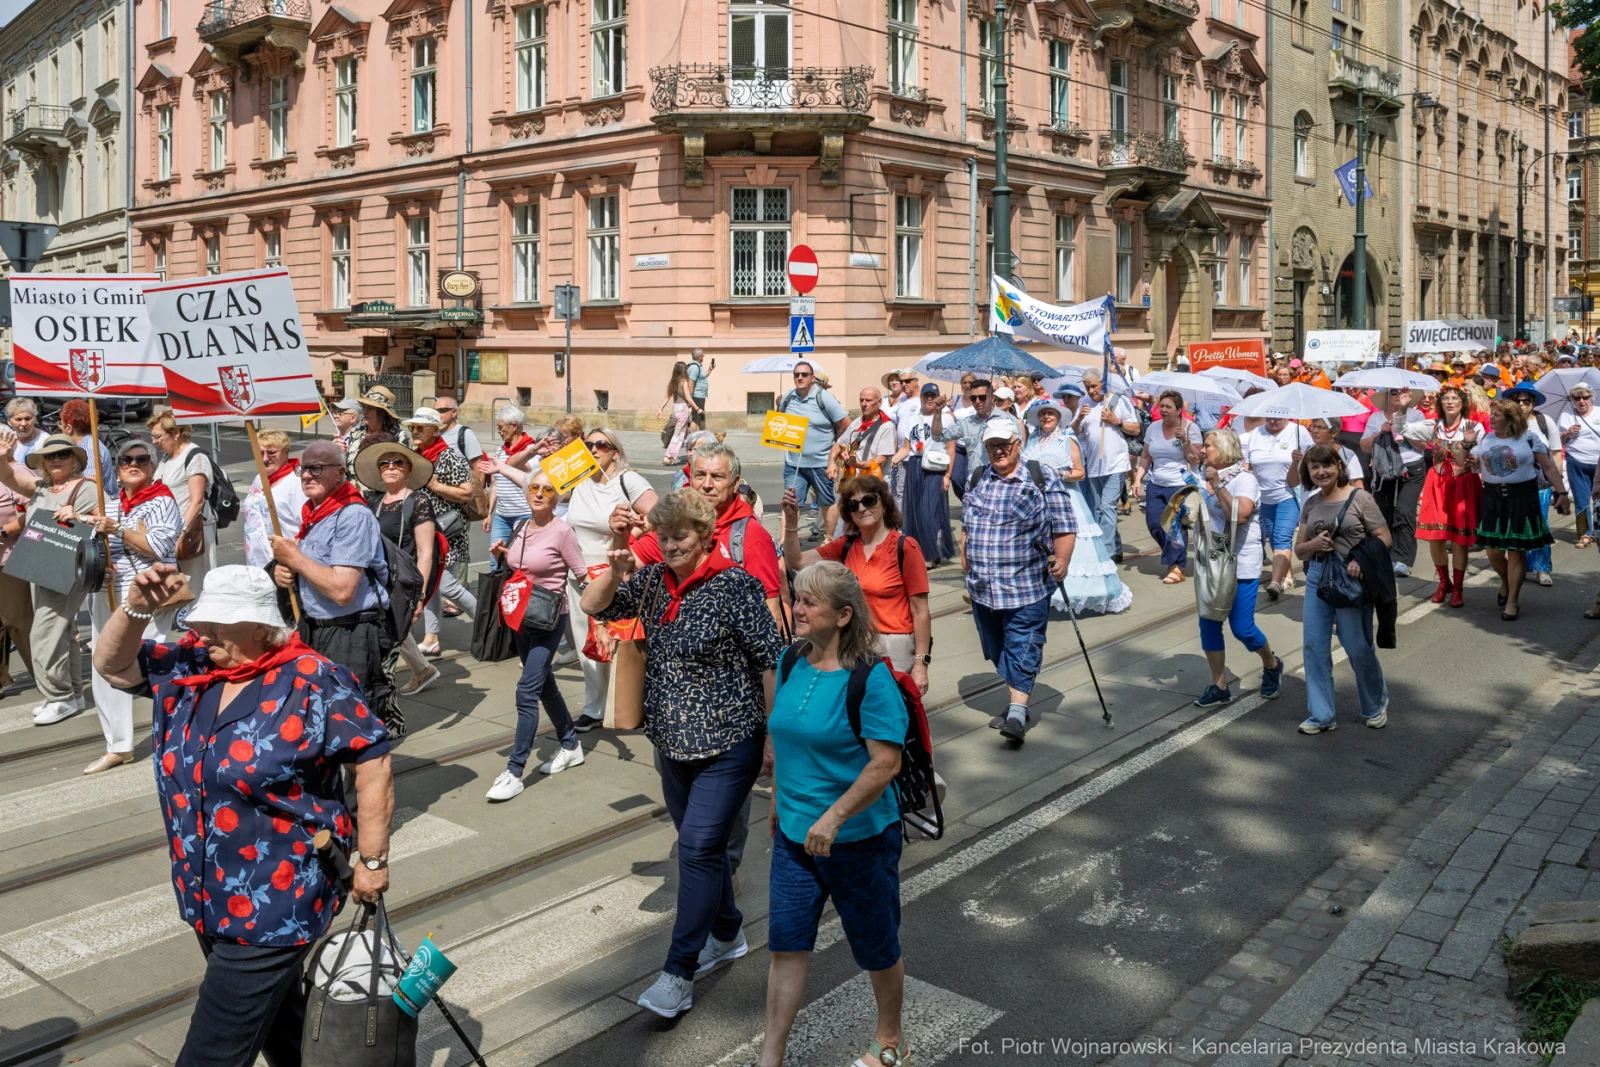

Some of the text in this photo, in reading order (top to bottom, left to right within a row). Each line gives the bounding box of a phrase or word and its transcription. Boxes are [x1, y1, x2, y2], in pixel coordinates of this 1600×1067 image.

[13, 287, 76, 304] Miasto
[82, 287, 88, 304] i
[176, 284, 262, 322] CZAS
[35, 315, 139, 342] OSIEK
[1024, 312, 1070, 331] SENIORZY
[158, 318, 301, 361] DLA NAS
[1052, 334, 1089, 346] TYCZYN
[1409, 326, 1494, 346] ŚWIĘCIECHOW
[1193, 346, 1260, 364] Pretty Women
[30, 520, 57, 534] Literacki
